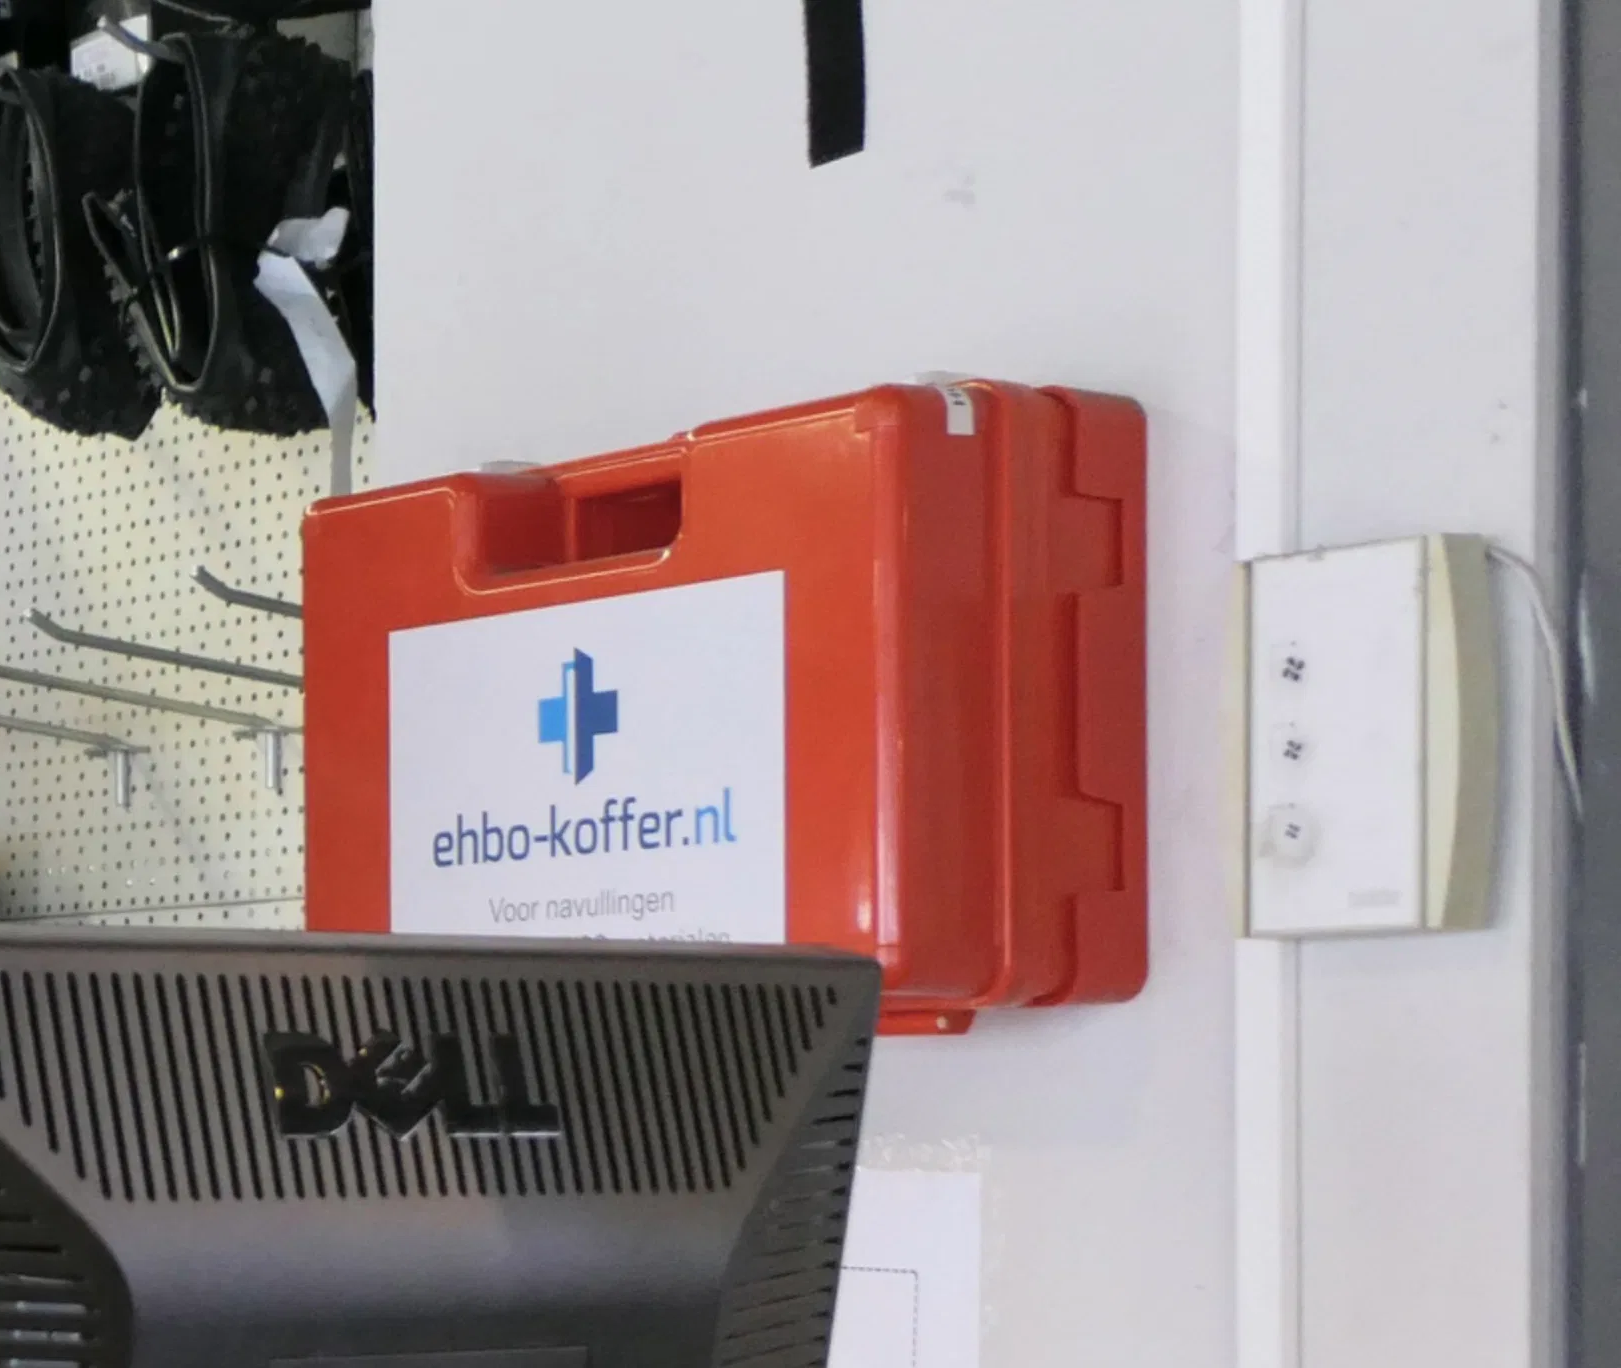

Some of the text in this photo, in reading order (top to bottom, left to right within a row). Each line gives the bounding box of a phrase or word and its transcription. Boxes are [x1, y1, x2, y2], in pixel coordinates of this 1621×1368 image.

[433, 787, 737, 867] ehbo-koffer.nl
[488, 888, 675, 923] Voor navullingen
[263, 1029, 560, 1141] DELL
